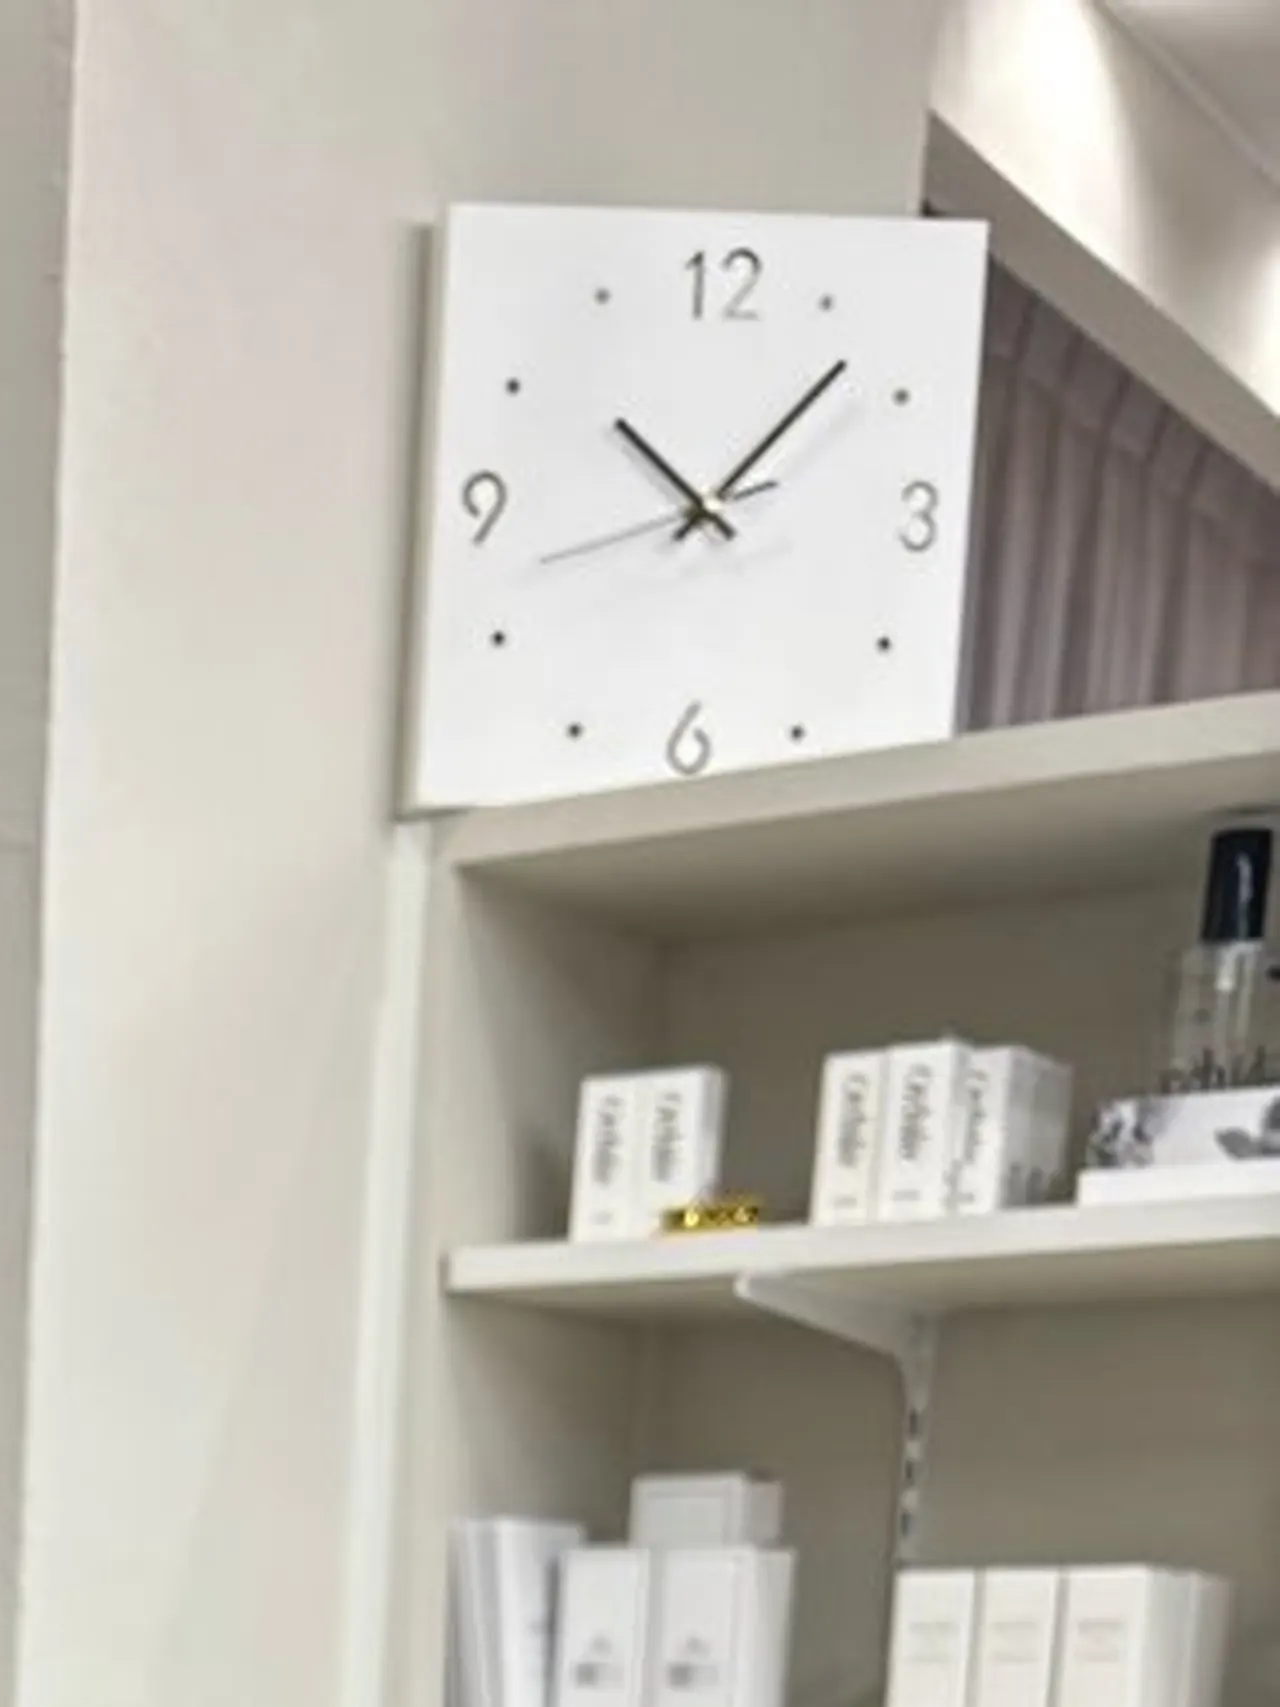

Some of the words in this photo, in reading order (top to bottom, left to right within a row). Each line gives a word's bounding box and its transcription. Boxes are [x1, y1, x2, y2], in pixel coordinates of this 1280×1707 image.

[682, 246, 763, 320] 12
[461, 469, 508, 547] 9
[899, 480, 939, 554] 3
[666, 702, 712, 775] 6
